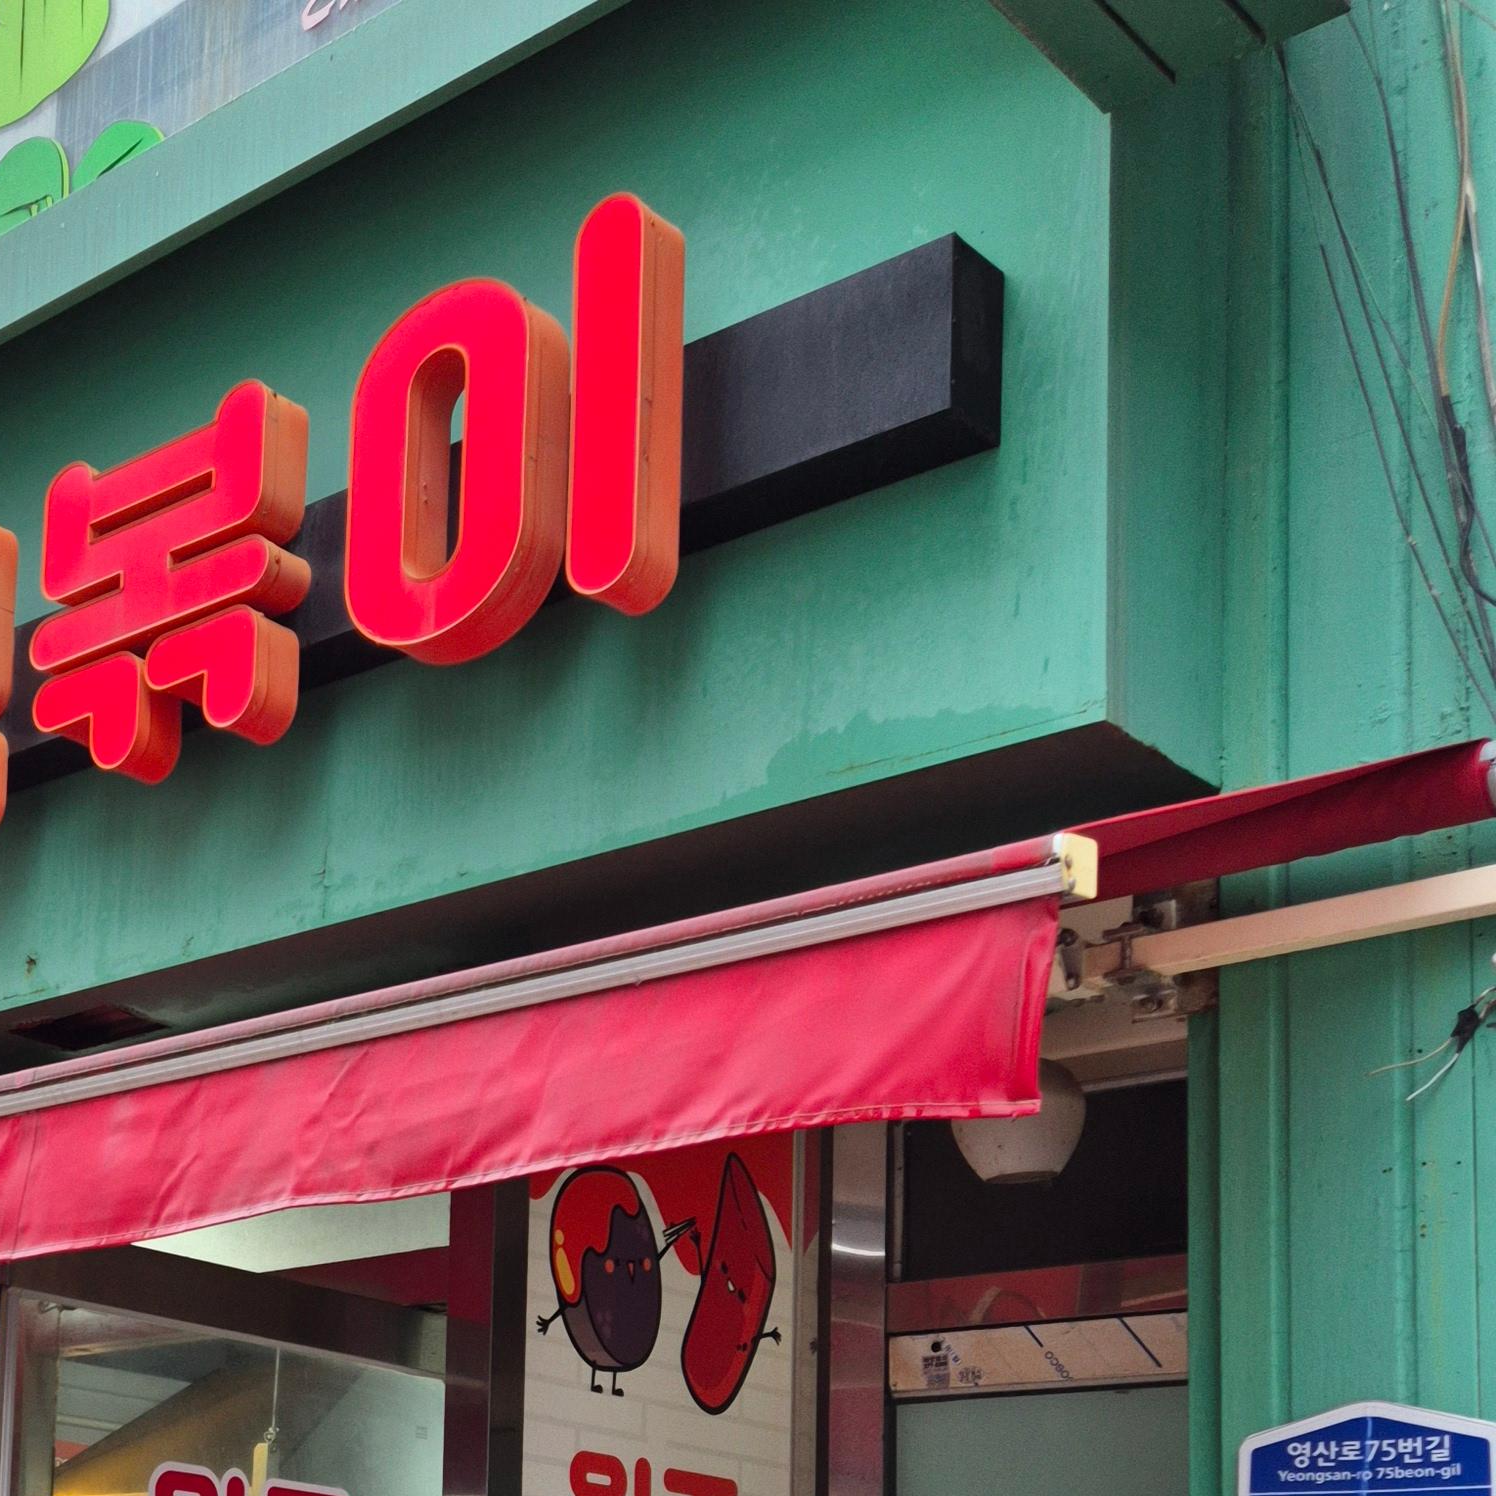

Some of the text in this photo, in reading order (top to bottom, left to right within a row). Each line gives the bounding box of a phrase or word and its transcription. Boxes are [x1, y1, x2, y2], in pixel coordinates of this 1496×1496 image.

[1287, 1434, 1452, 1468] 영산로75번길
[1277, 1463, 1462, 1484] Yeongsan-ro 75beon-gil
